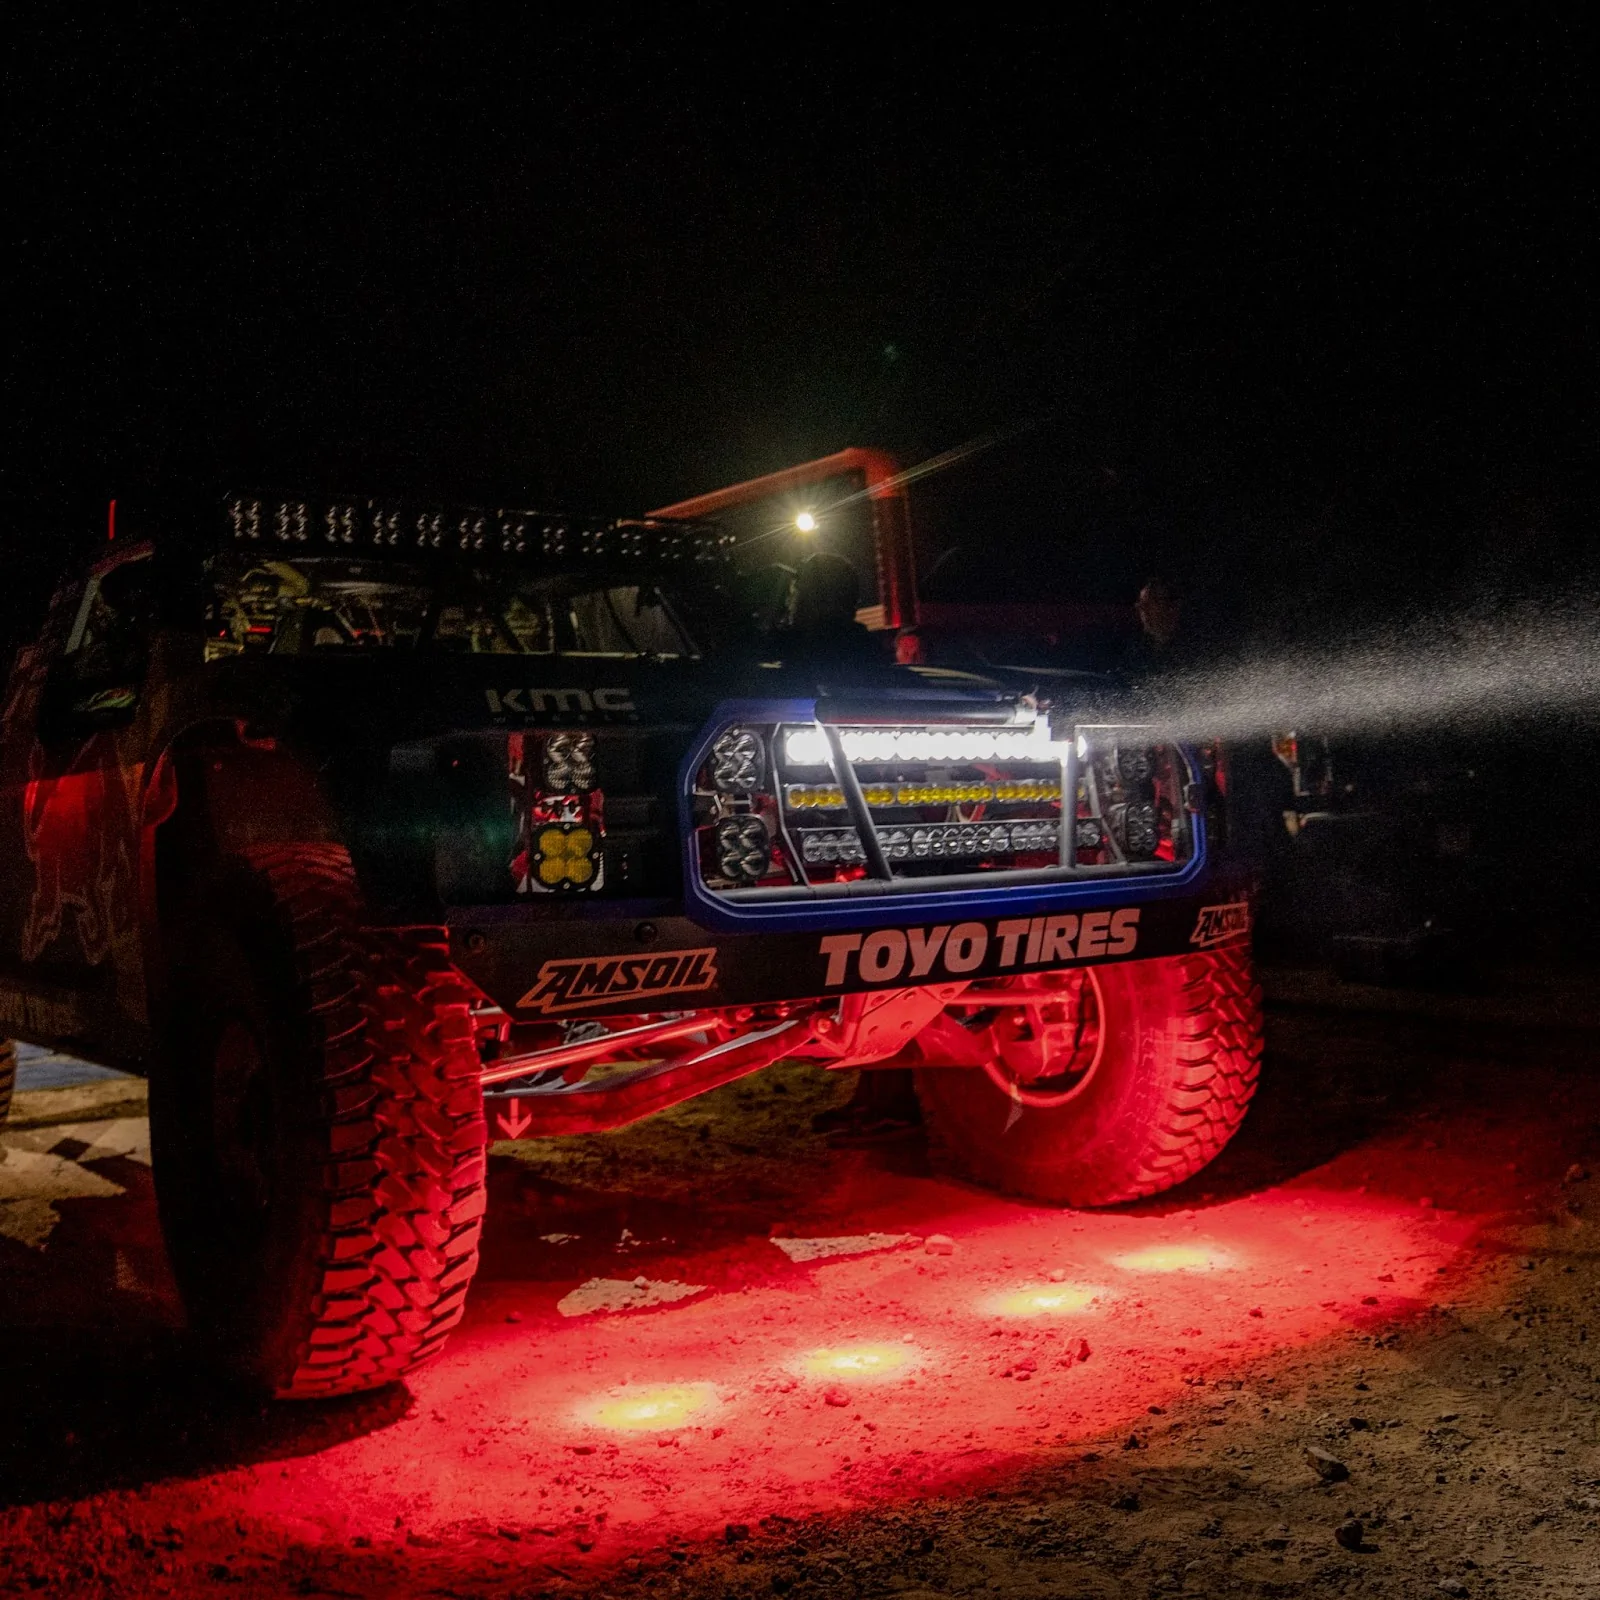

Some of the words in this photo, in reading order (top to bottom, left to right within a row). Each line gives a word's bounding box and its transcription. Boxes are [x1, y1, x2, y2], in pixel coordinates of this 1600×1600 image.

[516, 948, 718, 1014] AMSOIL
[819, 922, 989, 987] TOYO
[996, 908, 1141, 968] TIRES
